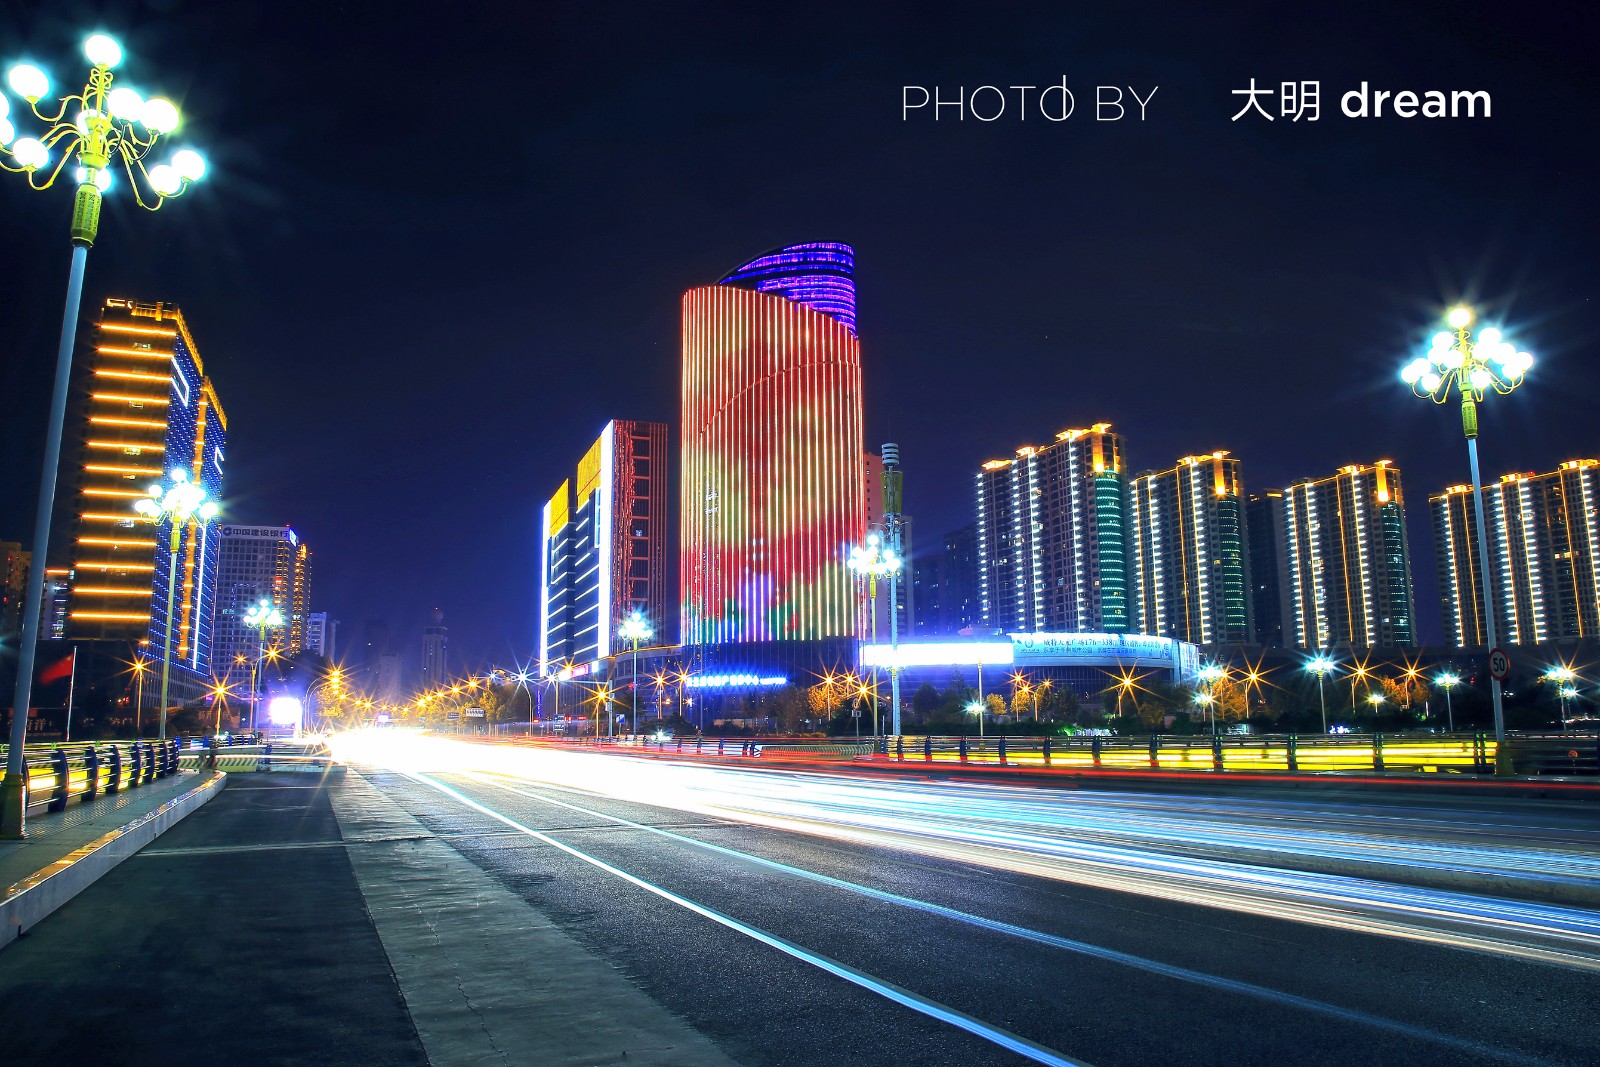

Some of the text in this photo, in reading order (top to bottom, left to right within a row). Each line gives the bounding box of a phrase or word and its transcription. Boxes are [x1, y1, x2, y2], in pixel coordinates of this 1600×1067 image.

[232, 528, 289, 538] 中国建设银行
[1492, 657, 1505, 672] 50
